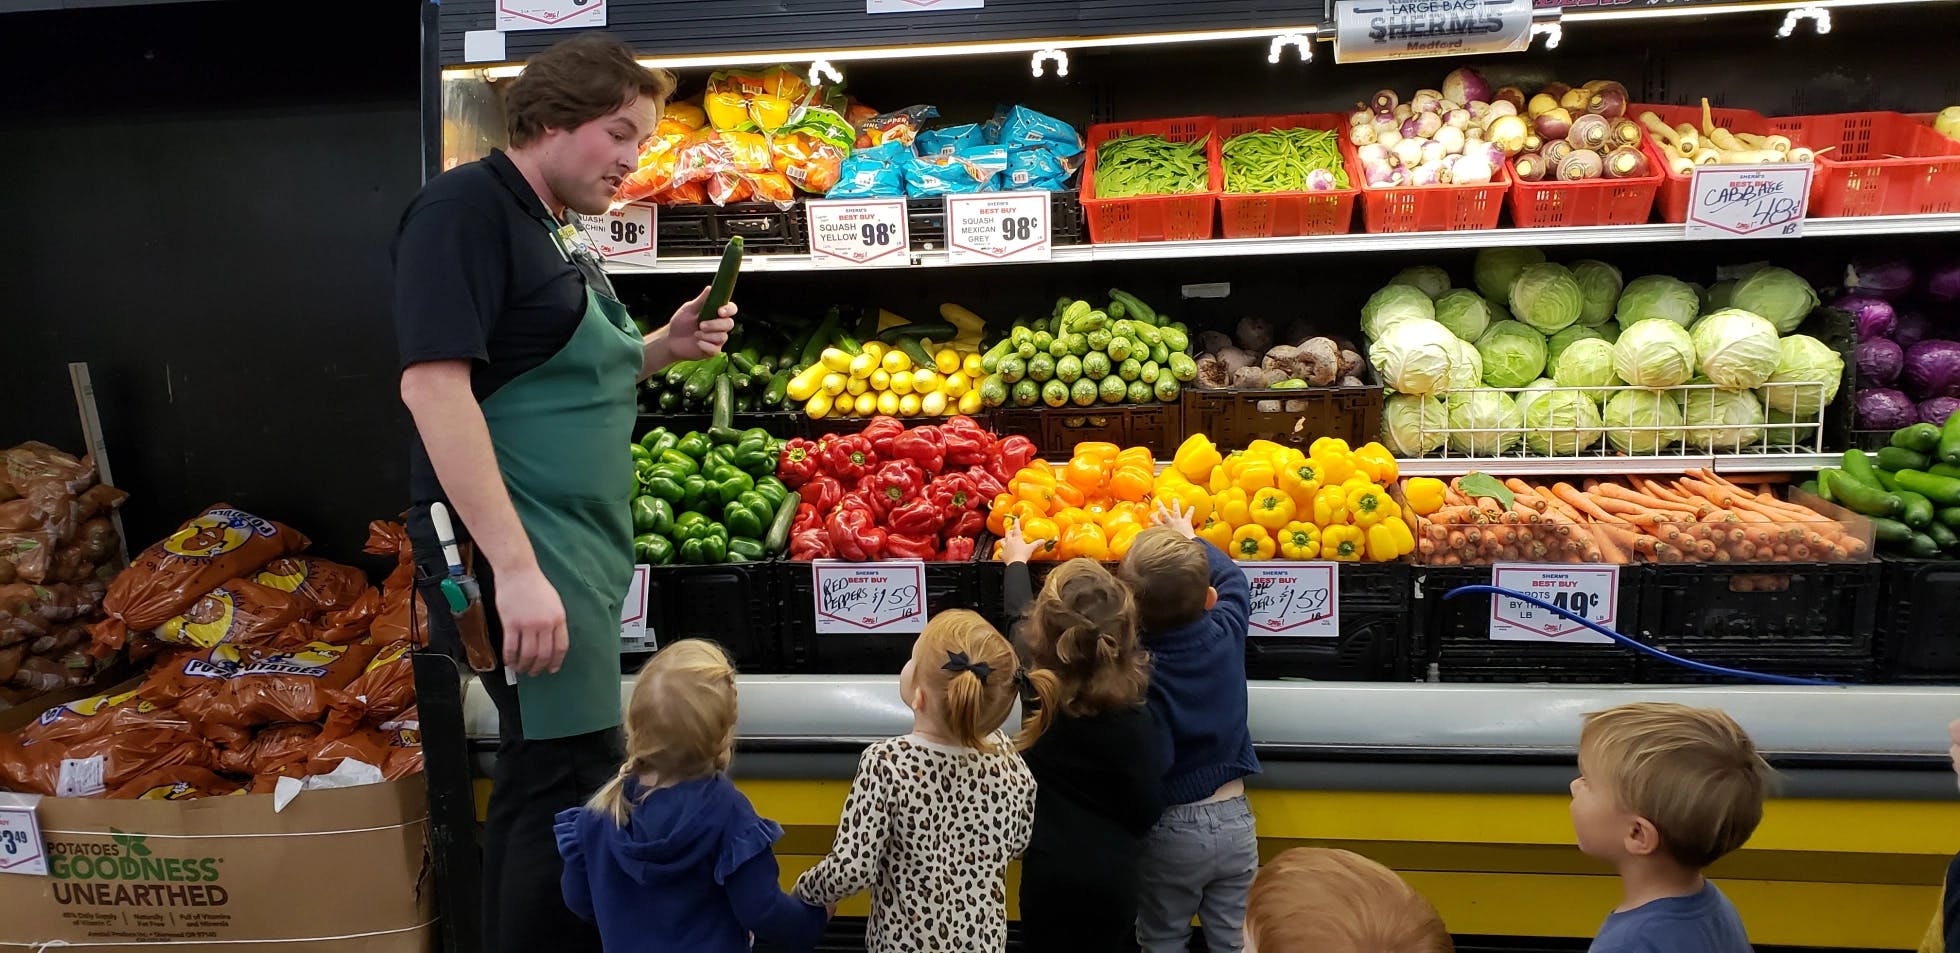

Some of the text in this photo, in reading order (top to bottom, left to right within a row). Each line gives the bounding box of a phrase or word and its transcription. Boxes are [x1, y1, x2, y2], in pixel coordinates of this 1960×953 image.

[1392, 0, 1476, 14] LARGE BAG
[1407, 39, 1463, 50] Medford
[1704, 181, 1784, 207] CABBAGE
[581, 216, 604, 224] UASH
[962, 217, 994, 225] SQUASH
[584, 223, 606, 232] CHINI
[819, 223, 857, 231] SQUASH
[961, 226, 996, 234] MEXICAN
[820, 233, 857, 242] YELLOW
[968, 235, 989, 243] GREY
[823, 577, 849, 594] RED
[824, 588, 868, 612] PEPPERS
[1249, 596, 1275, 615] PERS
[1510, 601, 1522, 609] BY
[47, 842, 120, 856] POTATOES
[50, 855, 219, 882] GOODNESS
[52, 882, 228, 906] UNEARTHED
